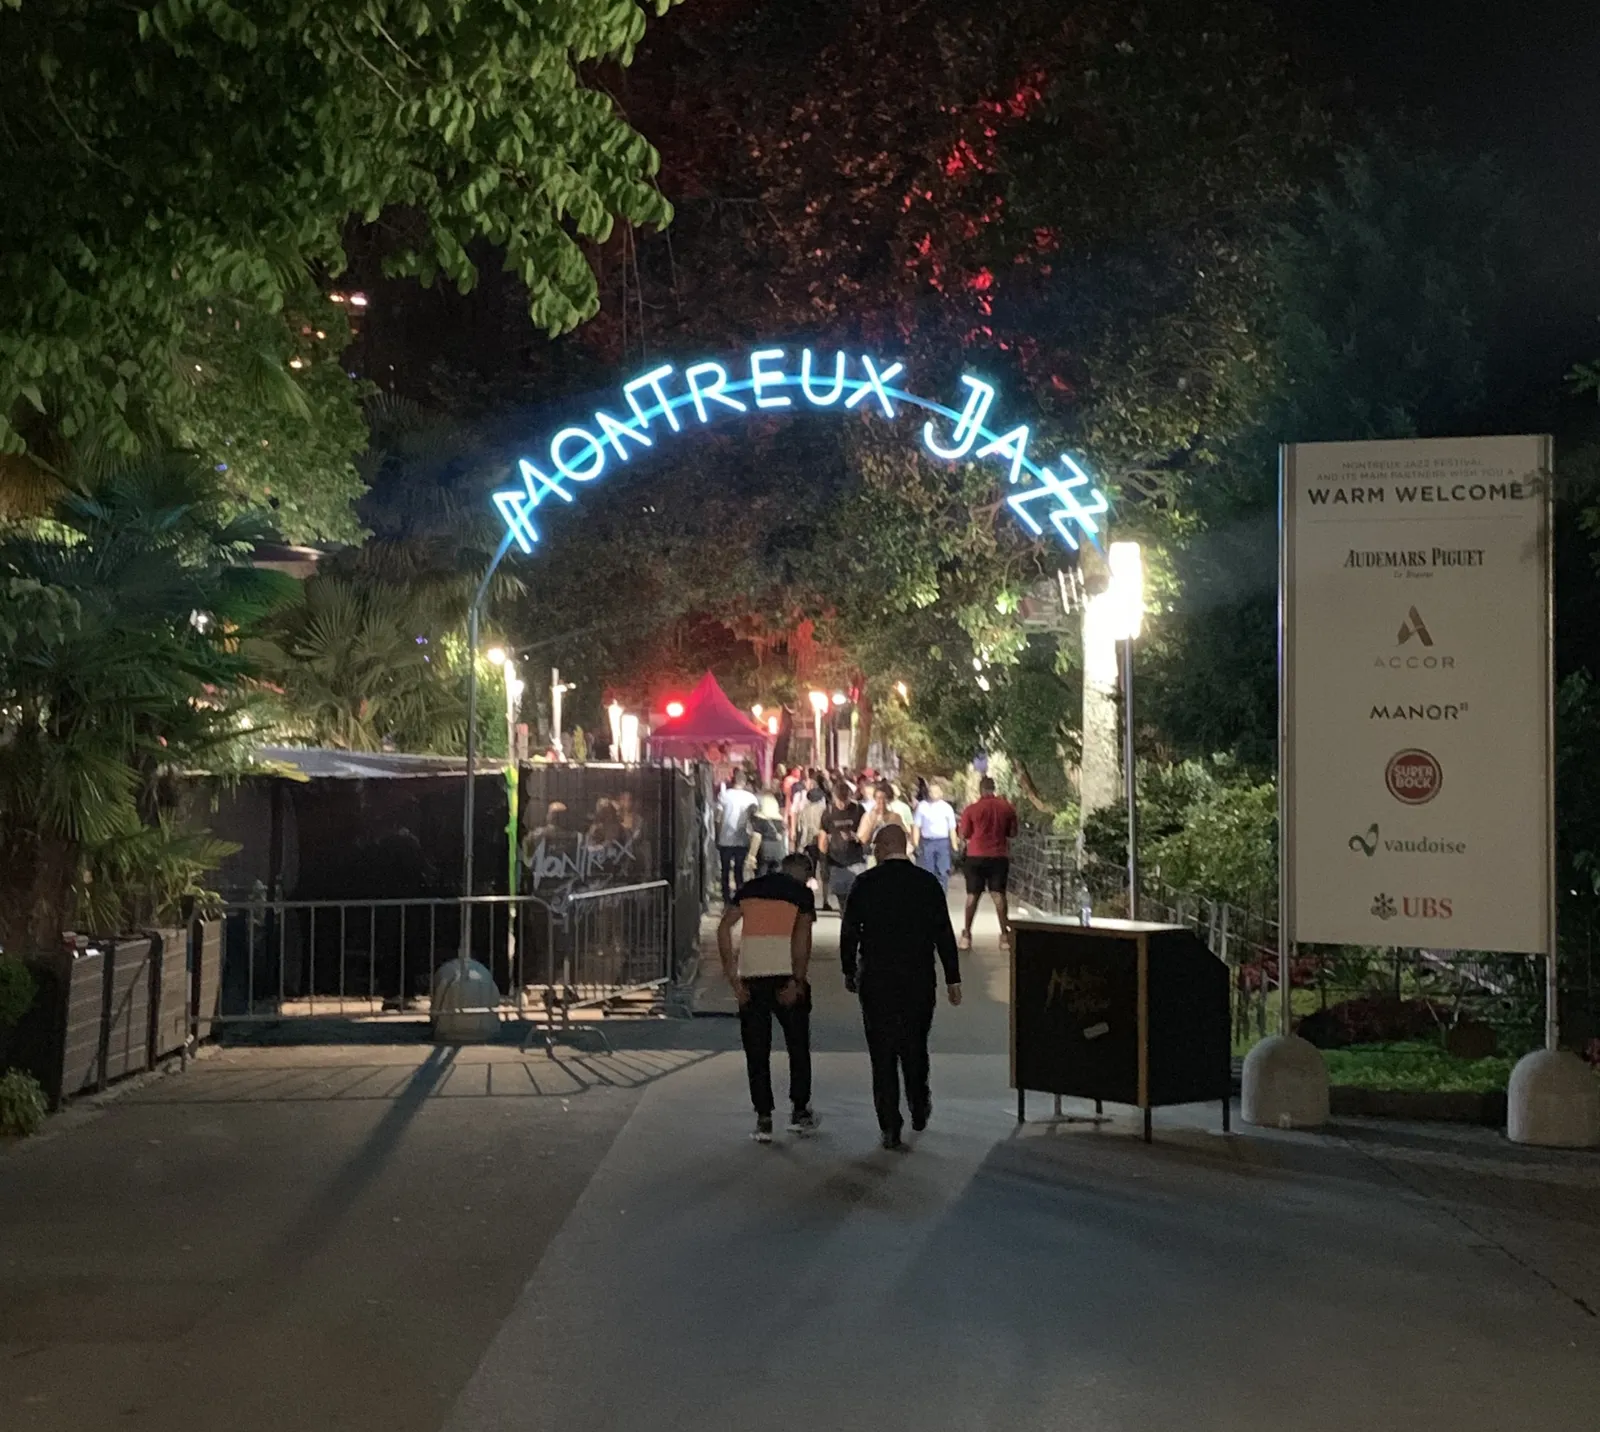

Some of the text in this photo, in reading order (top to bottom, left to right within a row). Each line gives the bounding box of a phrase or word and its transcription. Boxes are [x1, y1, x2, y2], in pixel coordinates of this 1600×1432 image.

[493, 347, 1109, 555] MONTREUX JAZZ
[1342, 458, 1484, 470] MONTREUX JAZZ FESTIVAL
[1316, 468, 1515, 482] AND ITS MAIN PARTNERS WISH YOU A
[1307, 480, 1524, 505] WARM WELCOME
[1343, 547, 1486, 568] AUDEMARS PIGUET
[1373, 656, 1455, 670] ACCOR
[1369, 704, 1460, 721] MANOR
[1394, 765, 1433, 777] SUPER
[1395, 776, 1432, 788] BOCK
[1384, 836, 1466, 855] vaudoise
[1402, 897, 1454, 919] UBS
